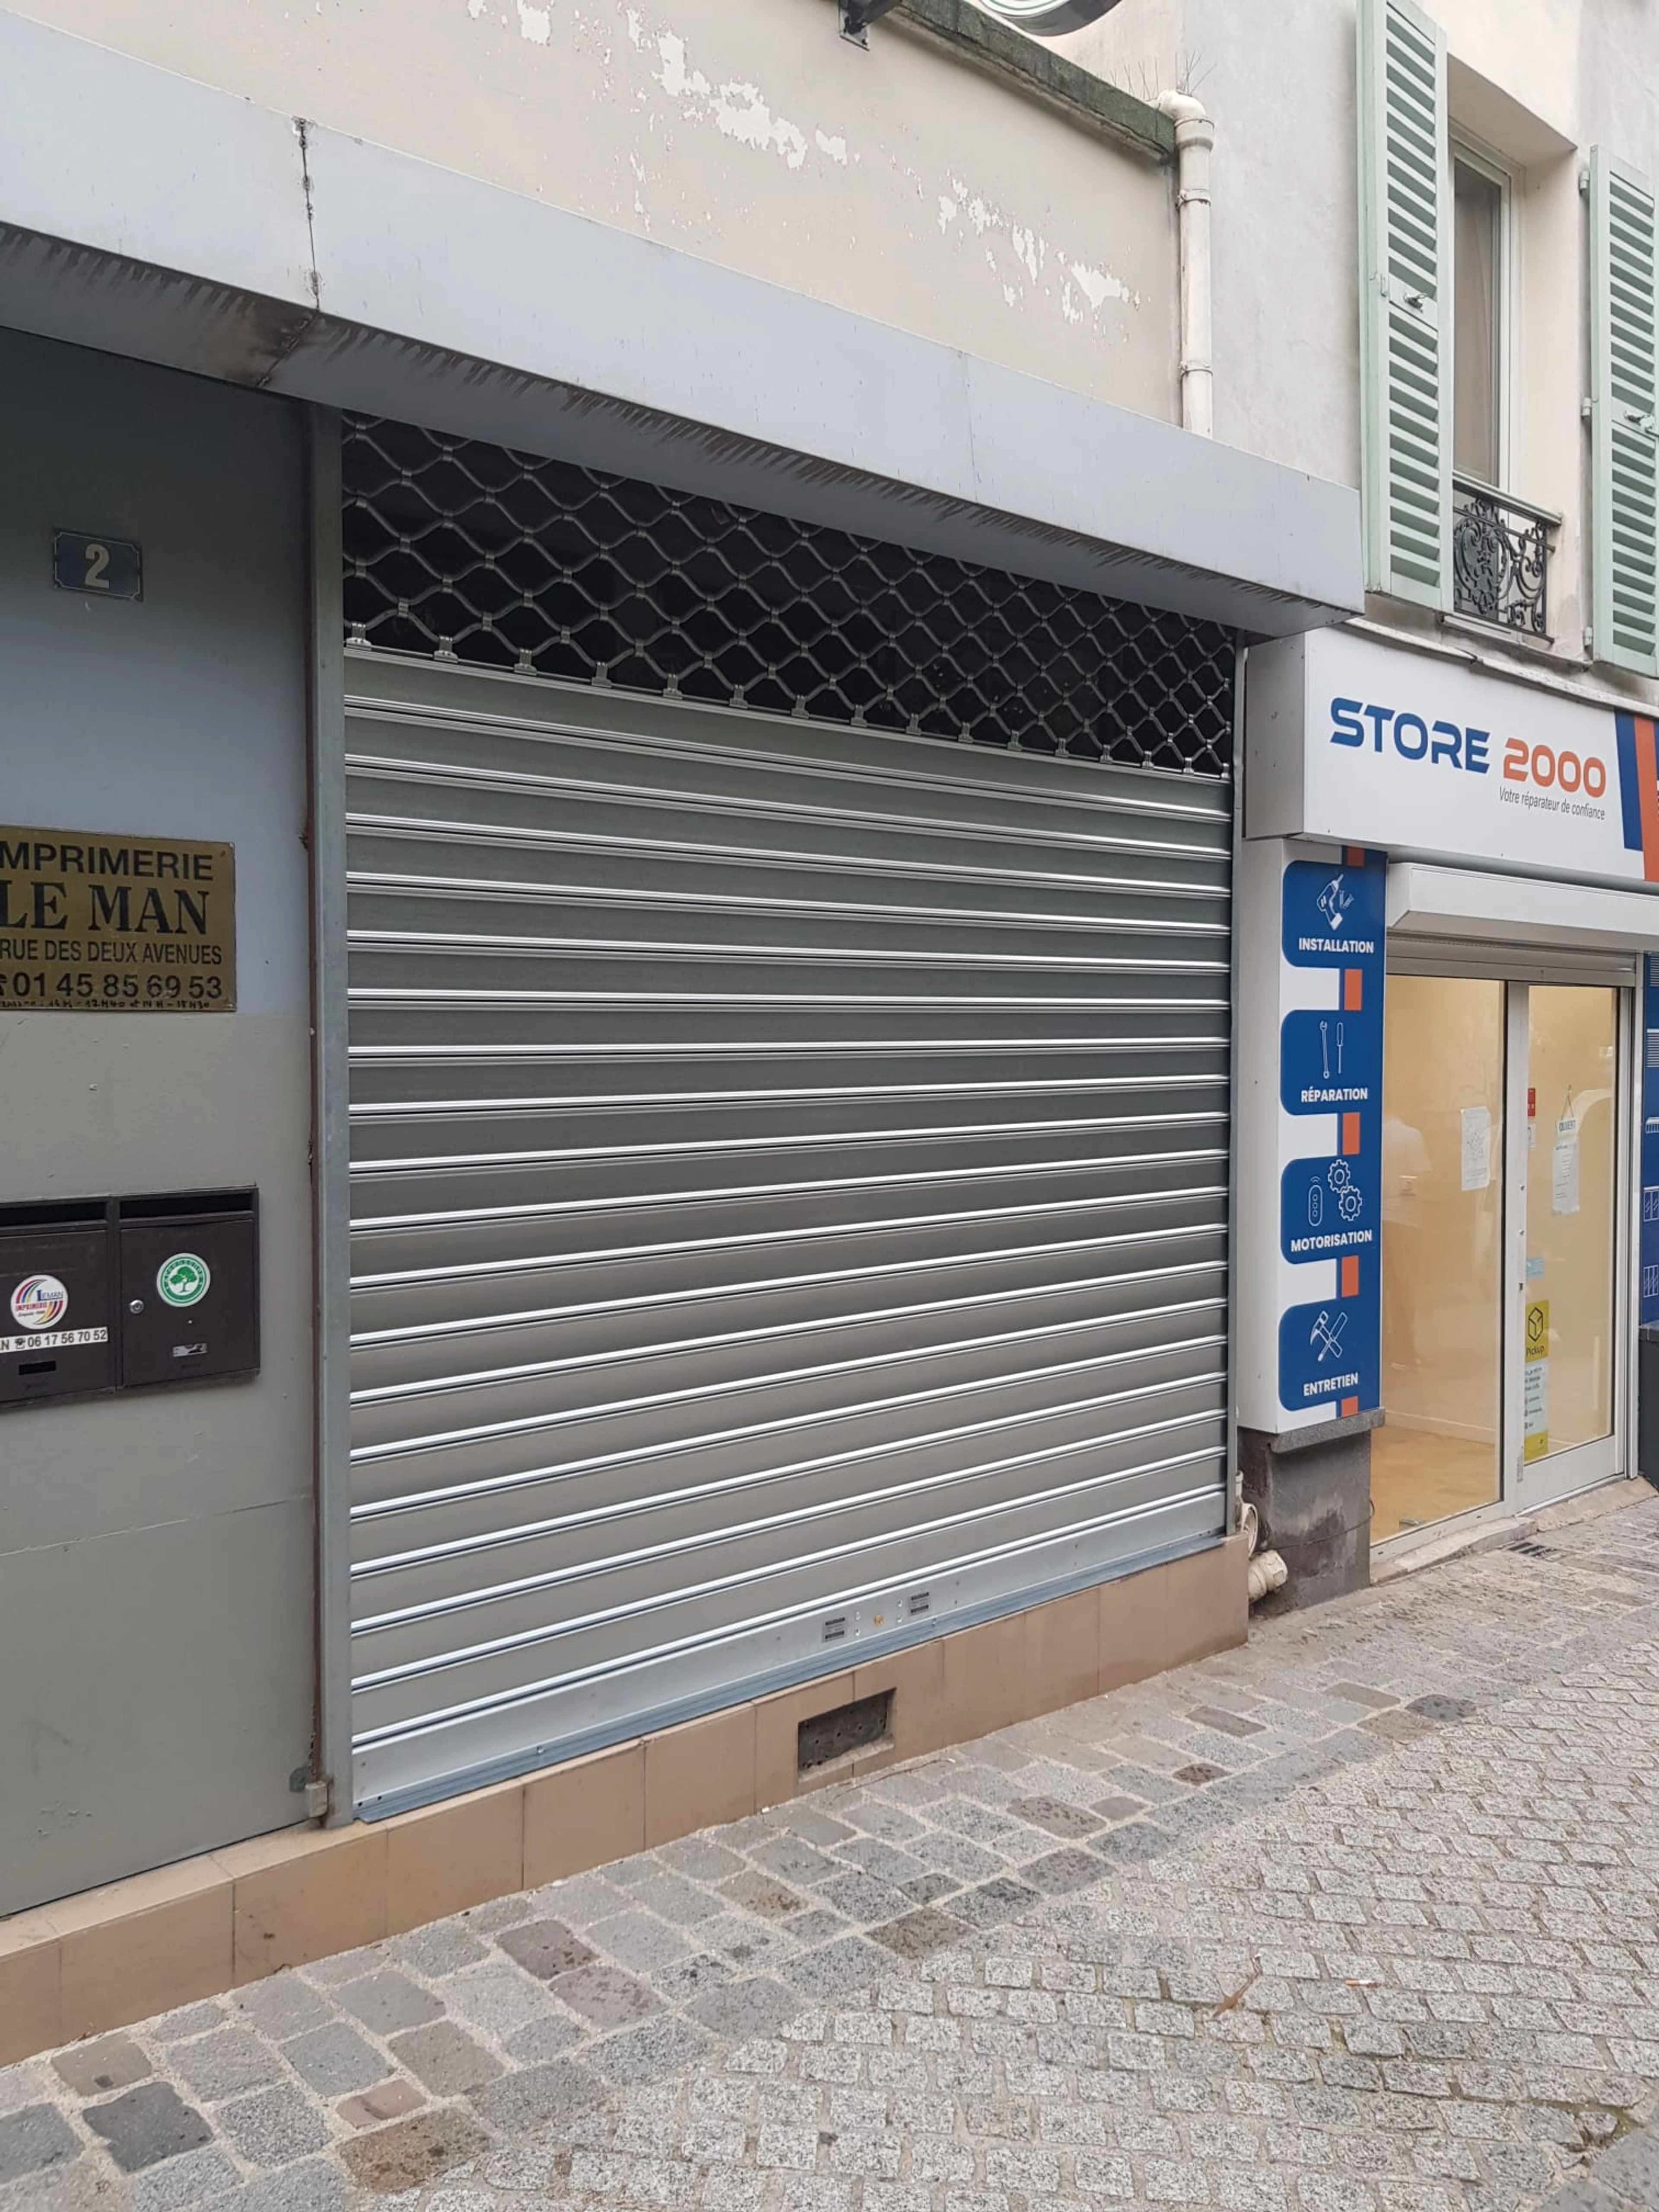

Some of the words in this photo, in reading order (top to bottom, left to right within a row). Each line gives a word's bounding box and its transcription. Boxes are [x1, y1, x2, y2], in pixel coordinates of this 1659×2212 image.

[84, 543, 109, 588] 2
[1330, 697, 1490, 774] STORE
[1503, 737, 1606, 798] 2000
[1500, 786, 1519, 804] Votre
[1522, 791, 1560, 810] réparateur
[1561, 799, 1570, 814] de
[1571, 803, 1605, 820] confiance
[0, 879, 68, 929] LE
[88, 884, 210, 934] MAN
[0, 938, 38, 960] RUE
[44, 940, 81, 961] DES
[88, 941, 137, 963] DEUX
[142, 943, 222, 965] AVENUES
[1299, 938, 1374, 954] INSTALLATION
[13, 972, 45, 997] 01
[56, 973, 93, 997] 45
[104, 974, 139, 998] 85
[147, 975, 181, 998] 69
[189, 976, 222, 999] 53
[1301, 1087, 1368, 1103] RÉPARATION
[1290, 1229, 1373, 1252] MOTORISATION
[0, 1338, 10, 1351] N
[27, 1336, 41, 1347] 06
[44, 1334, 58, 1345] 17
[61, 1333, 74, 1344] 56
[78, 1331, 91, 1342] 70
[93, 1329, 107, 1340] 52
[1303, 1373, 1358, 1397] ENTRETIEN
